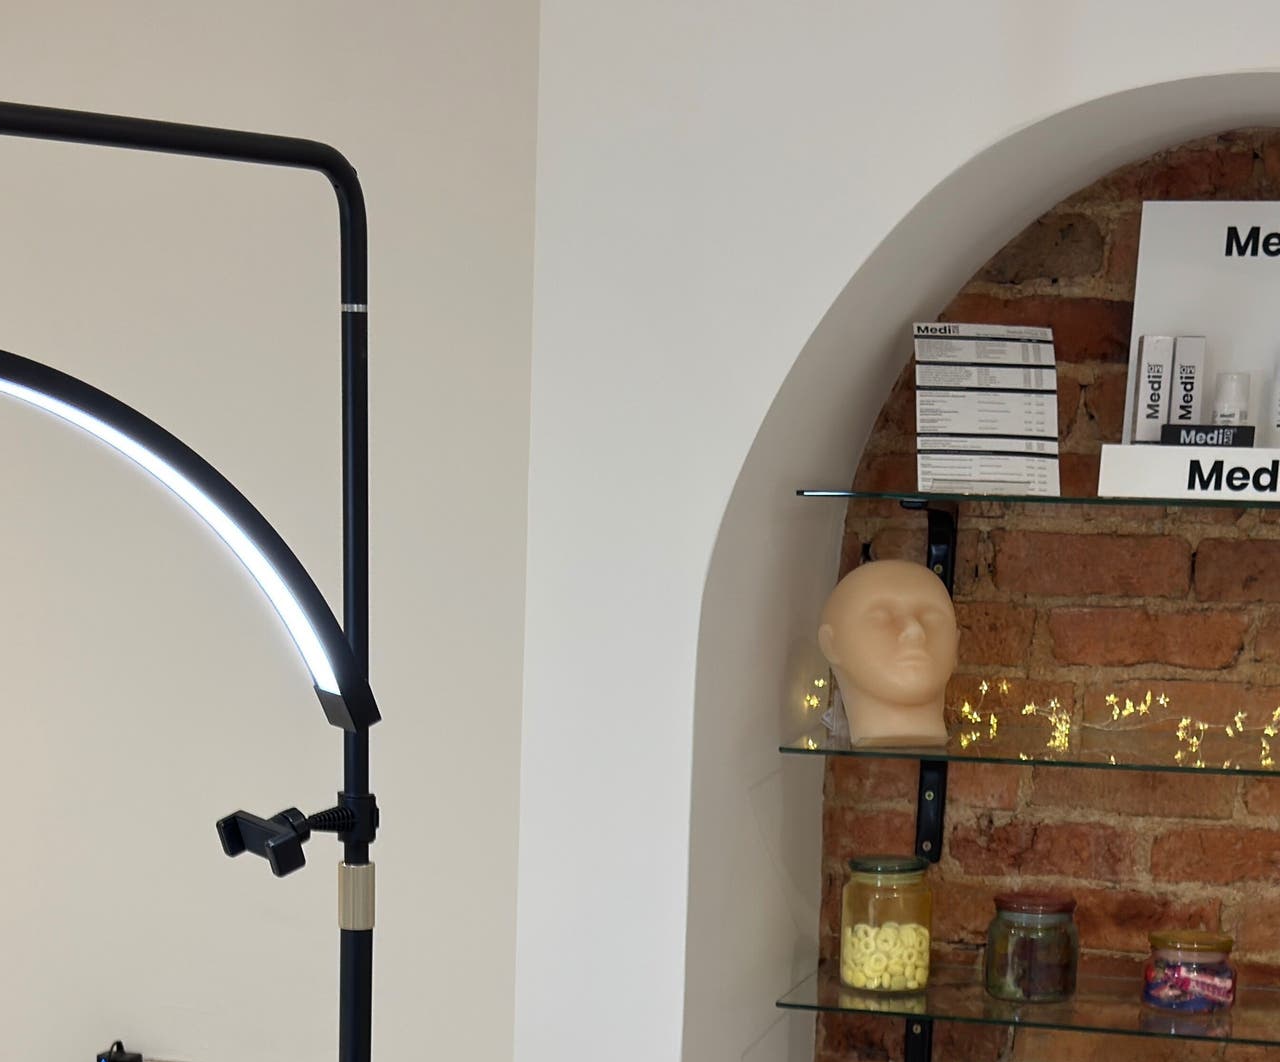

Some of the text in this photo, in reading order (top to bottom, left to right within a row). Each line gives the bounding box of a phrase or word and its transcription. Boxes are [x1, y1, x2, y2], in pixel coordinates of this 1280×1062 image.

[917, 325, 951, 335] Medi
[1146, 375, 1163, 419] Medi
[1178, 376, 1195, 420] Medi
[1180, 429, 1223, 445] Medi
